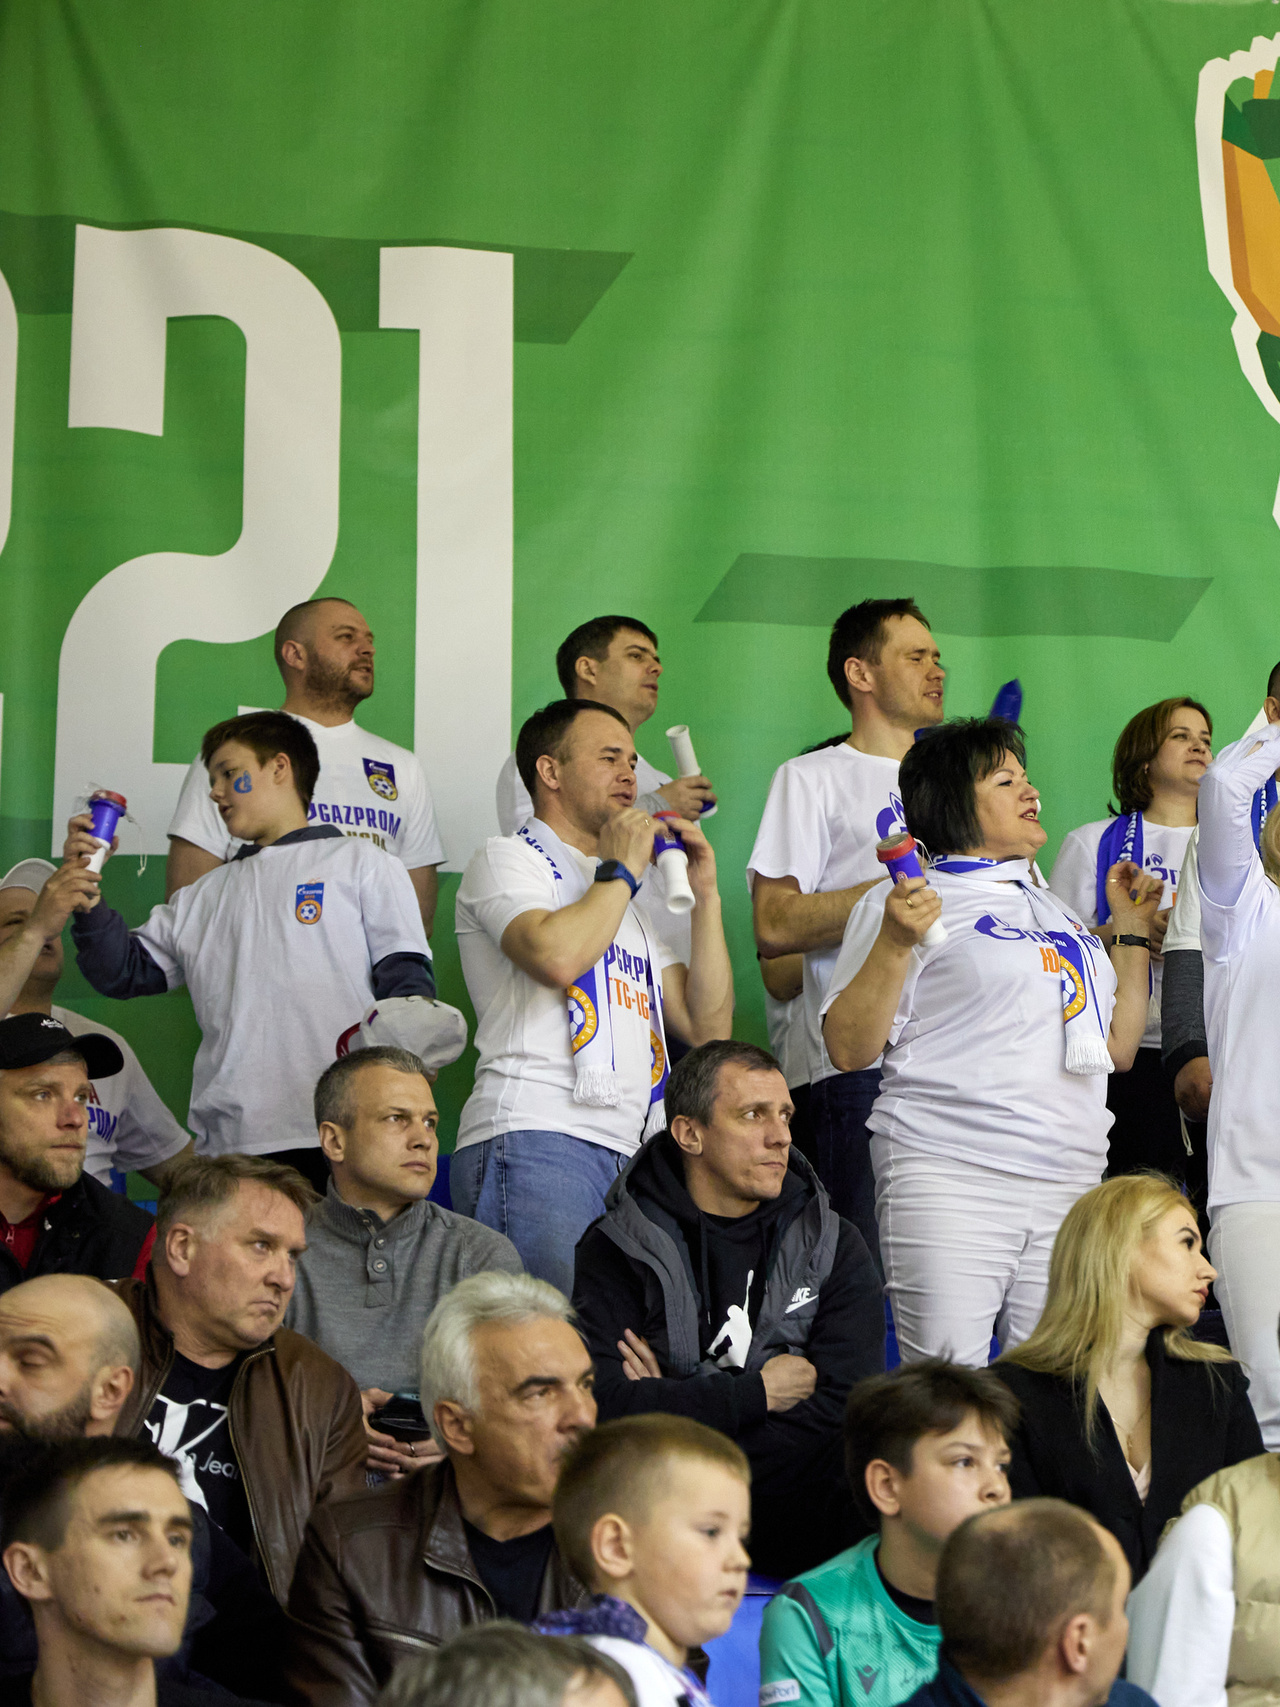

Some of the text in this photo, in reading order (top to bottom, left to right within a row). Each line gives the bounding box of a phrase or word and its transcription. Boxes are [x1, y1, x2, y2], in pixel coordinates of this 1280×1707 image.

[0, 223, 514, 871] 21
[317, 803, 402, 840] GAZPROM
[199, 1451, 240, 1479] Jea
